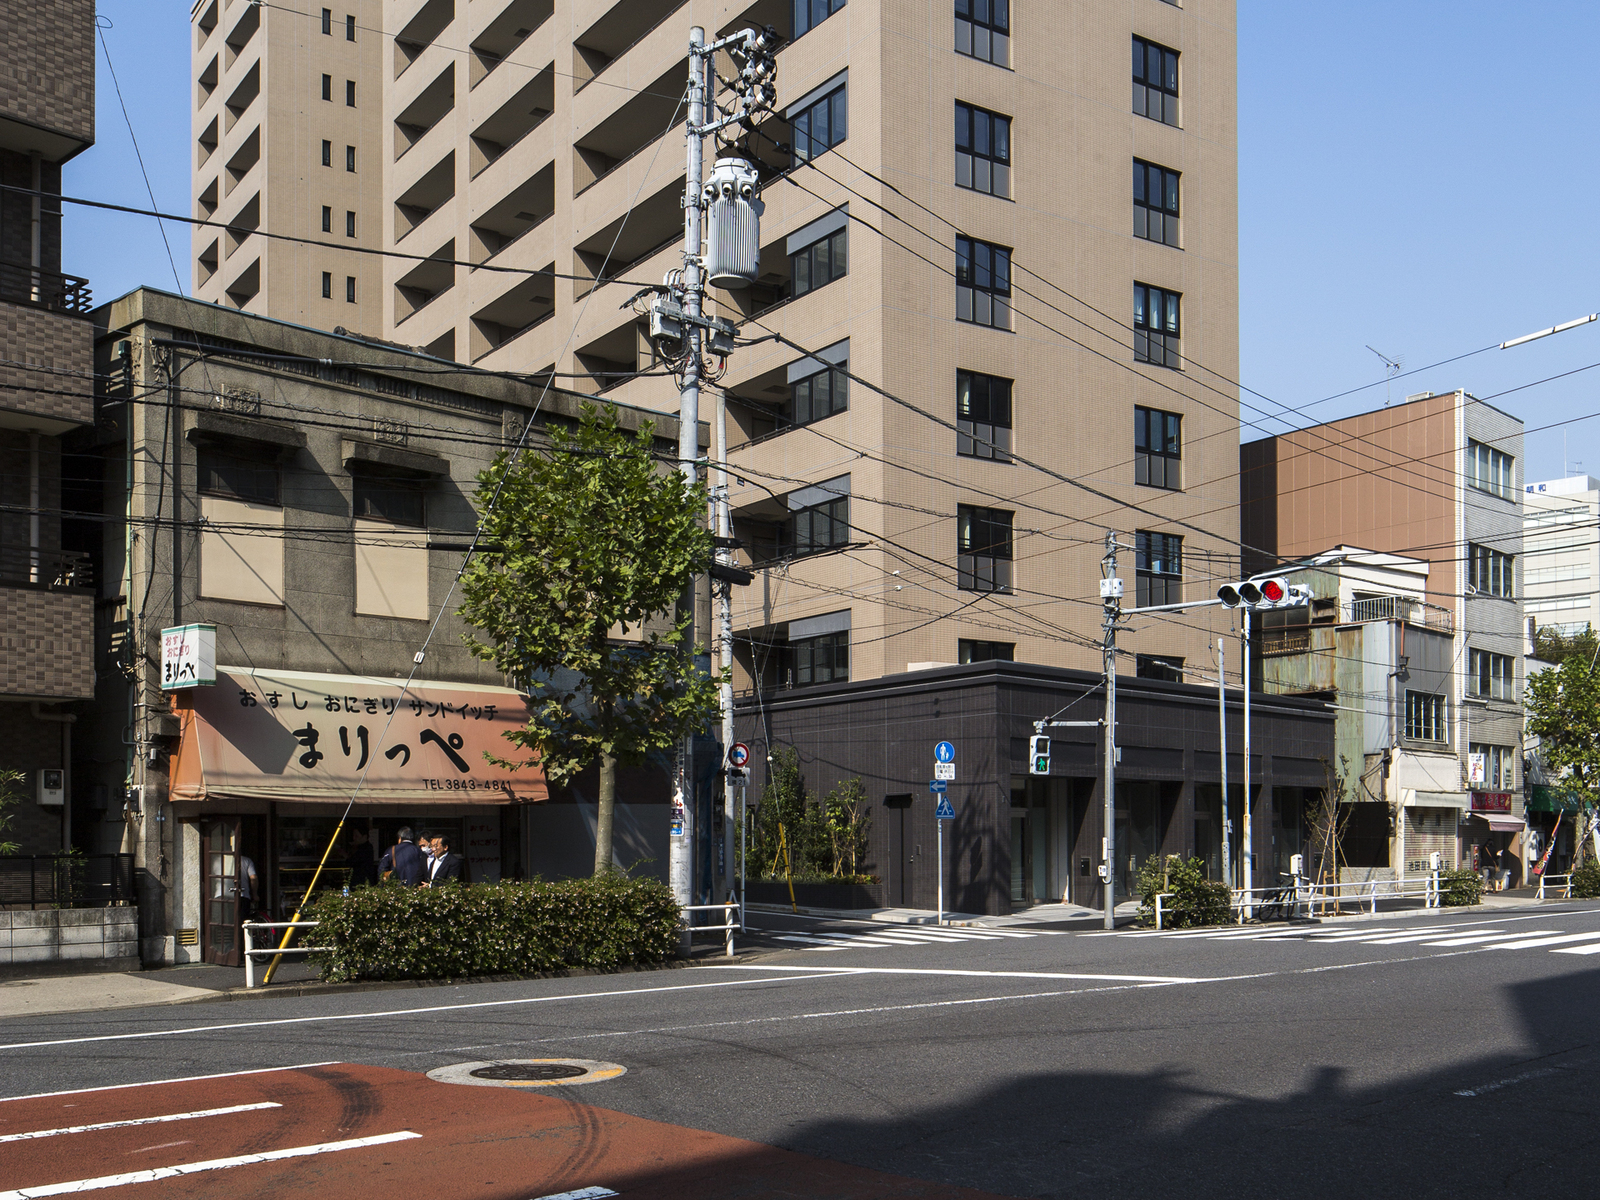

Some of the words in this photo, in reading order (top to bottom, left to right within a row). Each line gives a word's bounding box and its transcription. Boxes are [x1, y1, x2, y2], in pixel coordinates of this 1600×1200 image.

[165, 634, 185, 646] おすし
[167, 644, 190, 658] おにぎり
[165, 660, 195, 682] まりっぺ
[239, 689, 308, 710] おすし
[324, 695, 396, 715] おにぎり
[409, 700, 498, 721] サンドイッチ
[292, 721, 470, 773] まりっぺ
[422, 779, 443, 790] TEL
[446, 779, 512, 791] 3843-4841
